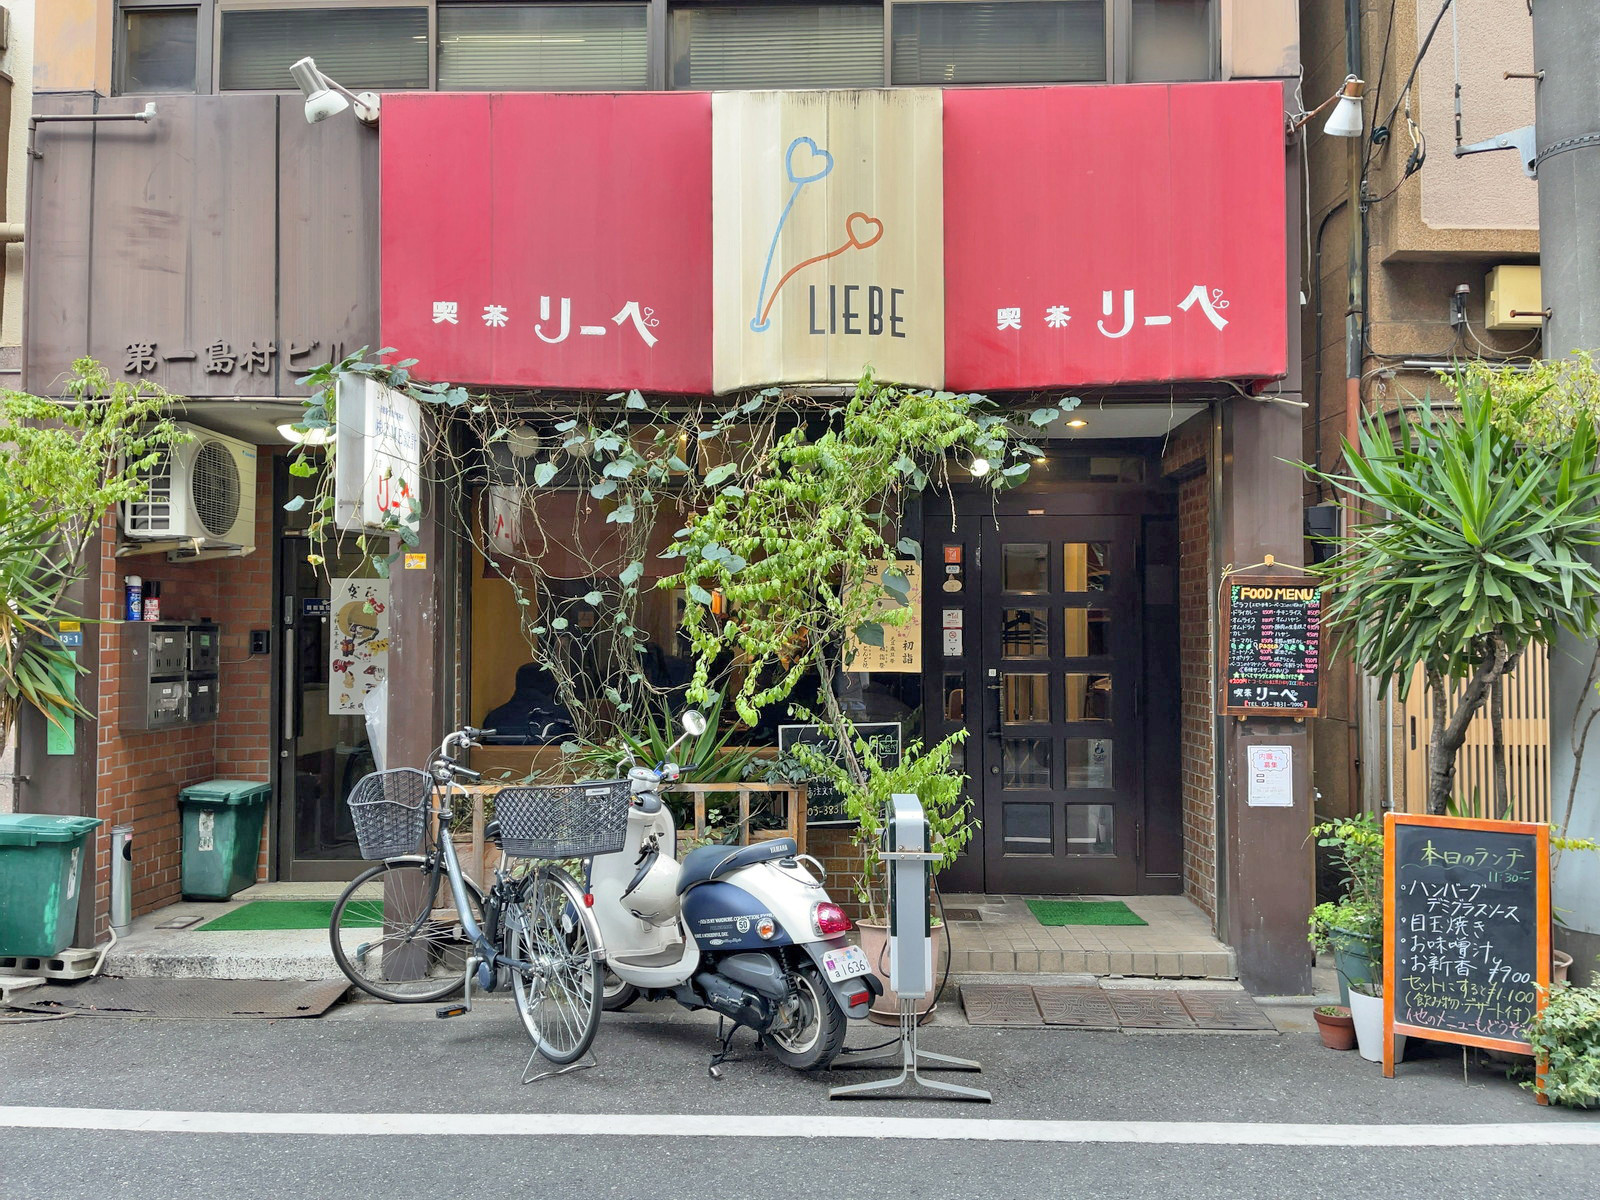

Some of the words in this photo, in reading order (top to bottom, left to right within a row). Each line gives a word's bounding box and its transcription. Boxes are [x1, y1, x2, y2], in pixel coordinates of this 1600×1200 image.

[432, 301, 509, 327] 喫茶
[535, 295, 659, 348] リーベ
[809, 285, 906, 338] LIEBE
[997, 305, 1071, 330] 喫茶
[1097, 285, 1229, 338] リーベ
[124, 339, 344, 374] 第一島村ビル
[1240, 587, 1273, 600] FOOD
[1274, 588, 1314, 601] MENU
[903, 640, 914, 664] 初詣
[1234, 688, 1253, 698] 喫茶
[1420, 840, 1525, 870] 本日のランチ
[1409, 880, 1487, 902] ハンバーグ
[1427, 898, 1520, 923] デミグラスソース
[739, 921, 748, 929] 50
[1411, 914, 1485, 939] 目玉焼き
[1410, 935, 1493, 964] お味噌汁
[842, 960, 866, 976] 1636
[1411, 953, 1477, 977] お新香
[1402, 975, 1486, 999] セットにすると
